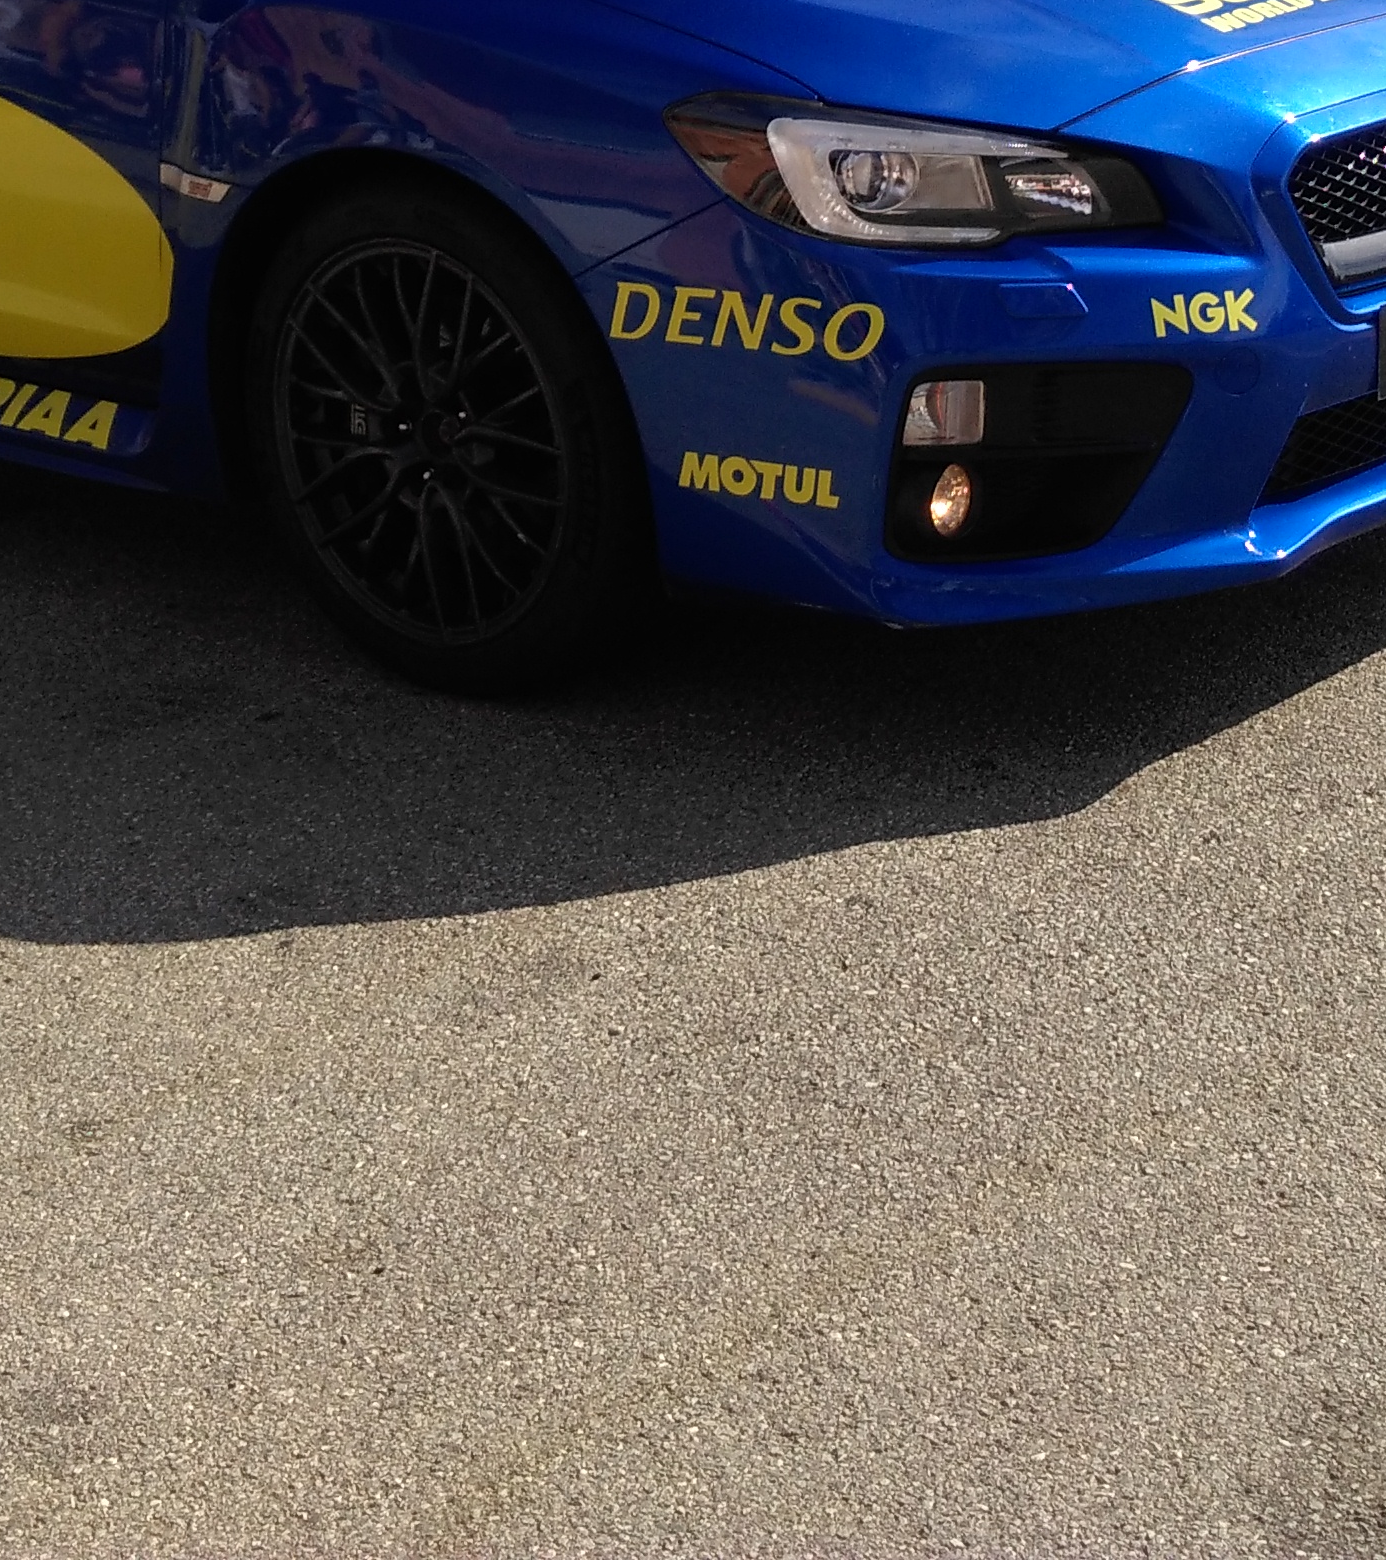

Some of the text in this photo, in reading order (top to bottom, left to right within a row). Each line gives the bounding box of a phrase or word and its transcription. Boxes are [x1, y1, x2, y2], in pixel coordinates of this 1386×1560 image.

[609, 281, 885, 361] DENSO
[1150, 288, 1258, 338] NGK
[678, 451, 840, 509] MOTUL
